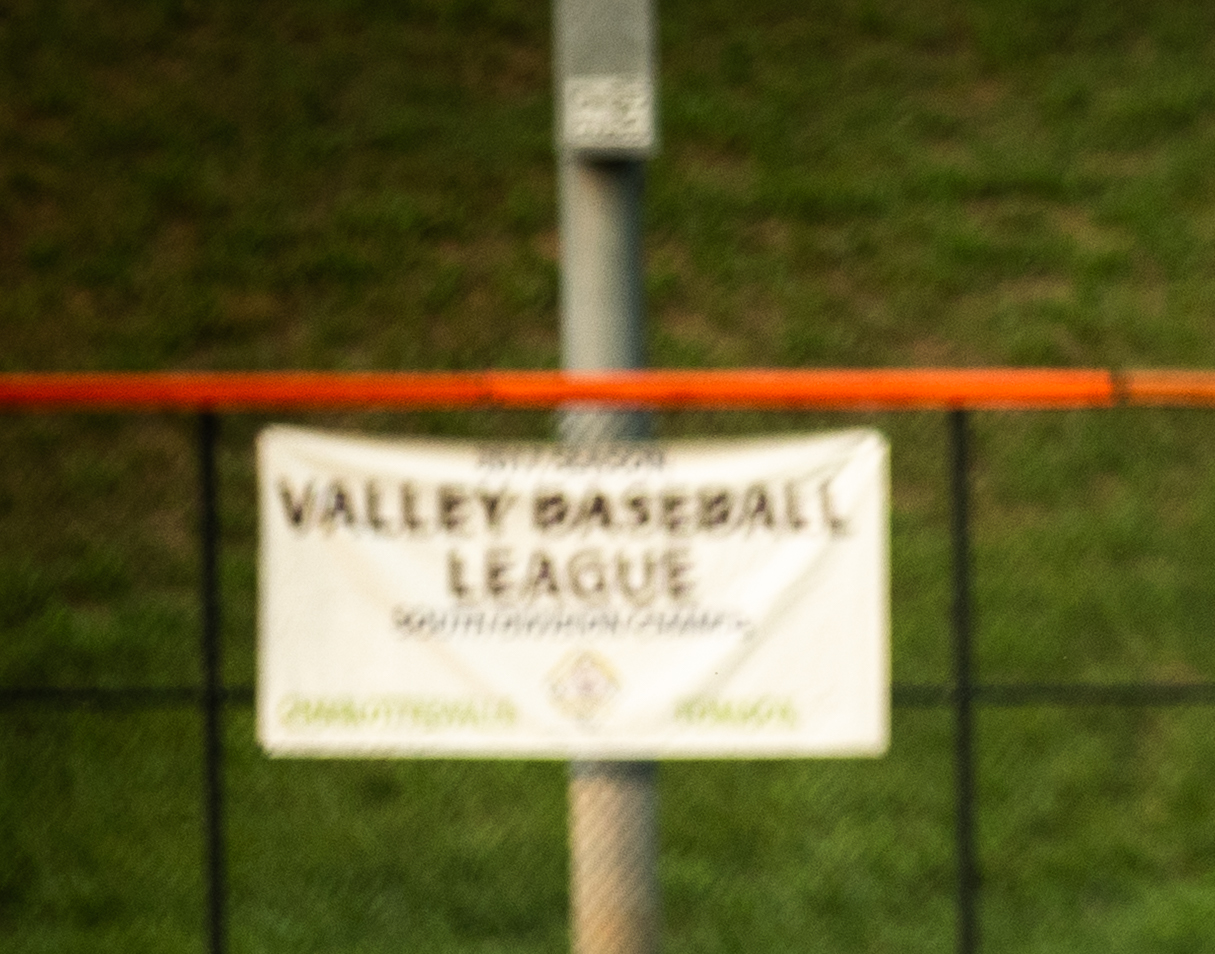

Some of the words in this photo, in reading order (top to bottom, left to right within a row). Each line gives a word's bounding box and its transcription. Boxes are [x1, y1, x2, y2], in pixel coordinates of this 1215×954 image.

[279, 478, 516, 537] VALLEY
[532, 483, 853, 541] BASEBALL
[446, 548, 696, 603] LEAGUE
